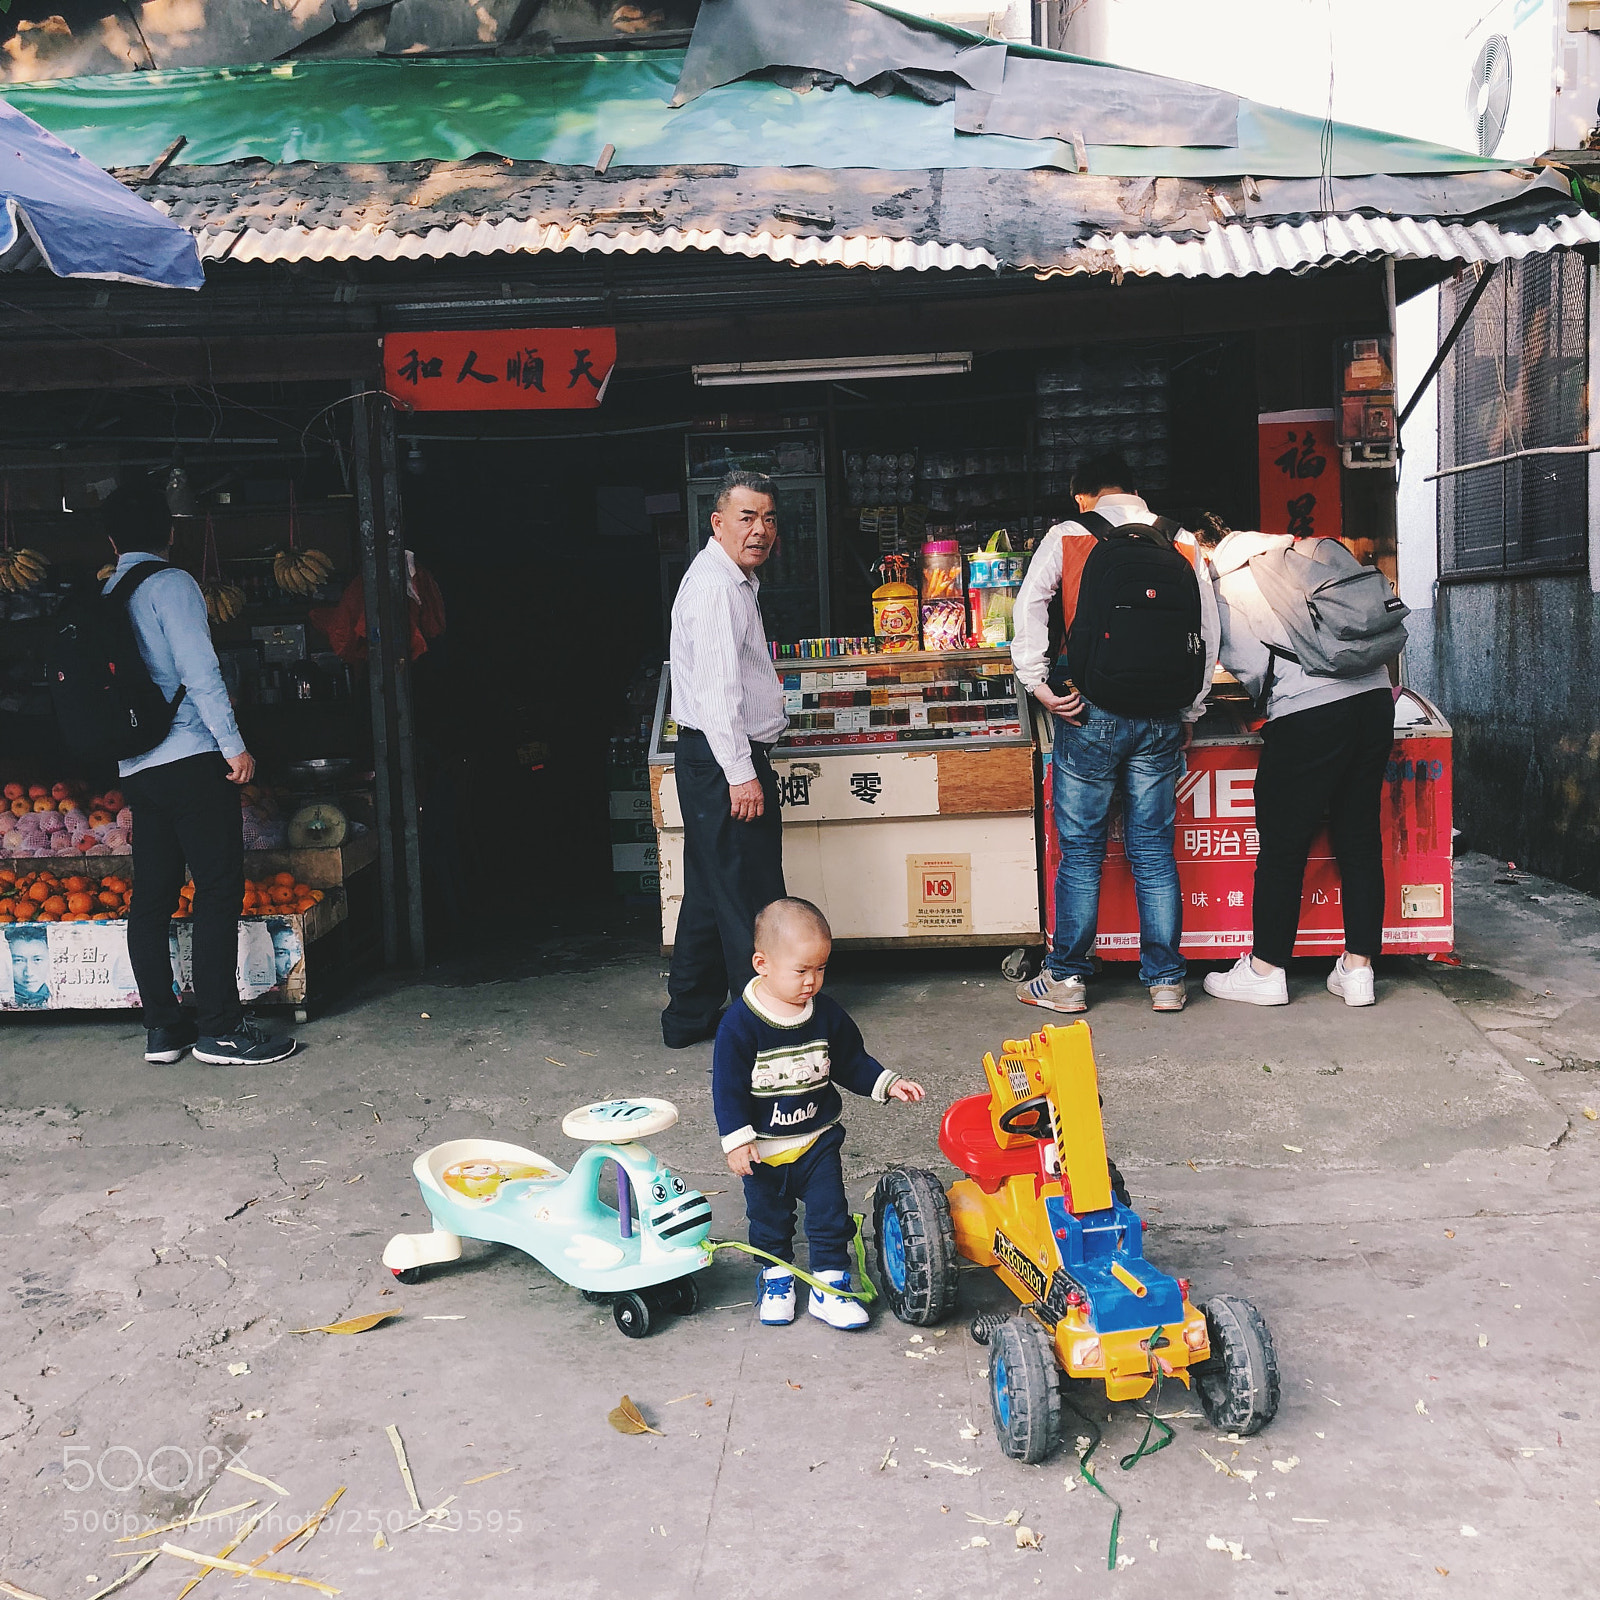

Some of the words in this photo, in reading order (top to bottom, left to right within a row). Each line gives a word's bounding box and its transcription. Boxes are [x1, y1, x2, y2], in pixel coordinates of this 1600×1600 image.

[926, 879, 952, 897] NO
[1112, 936, 1140, 945] 明治雪
[1214, 934, 1245, 943] MEIJI
